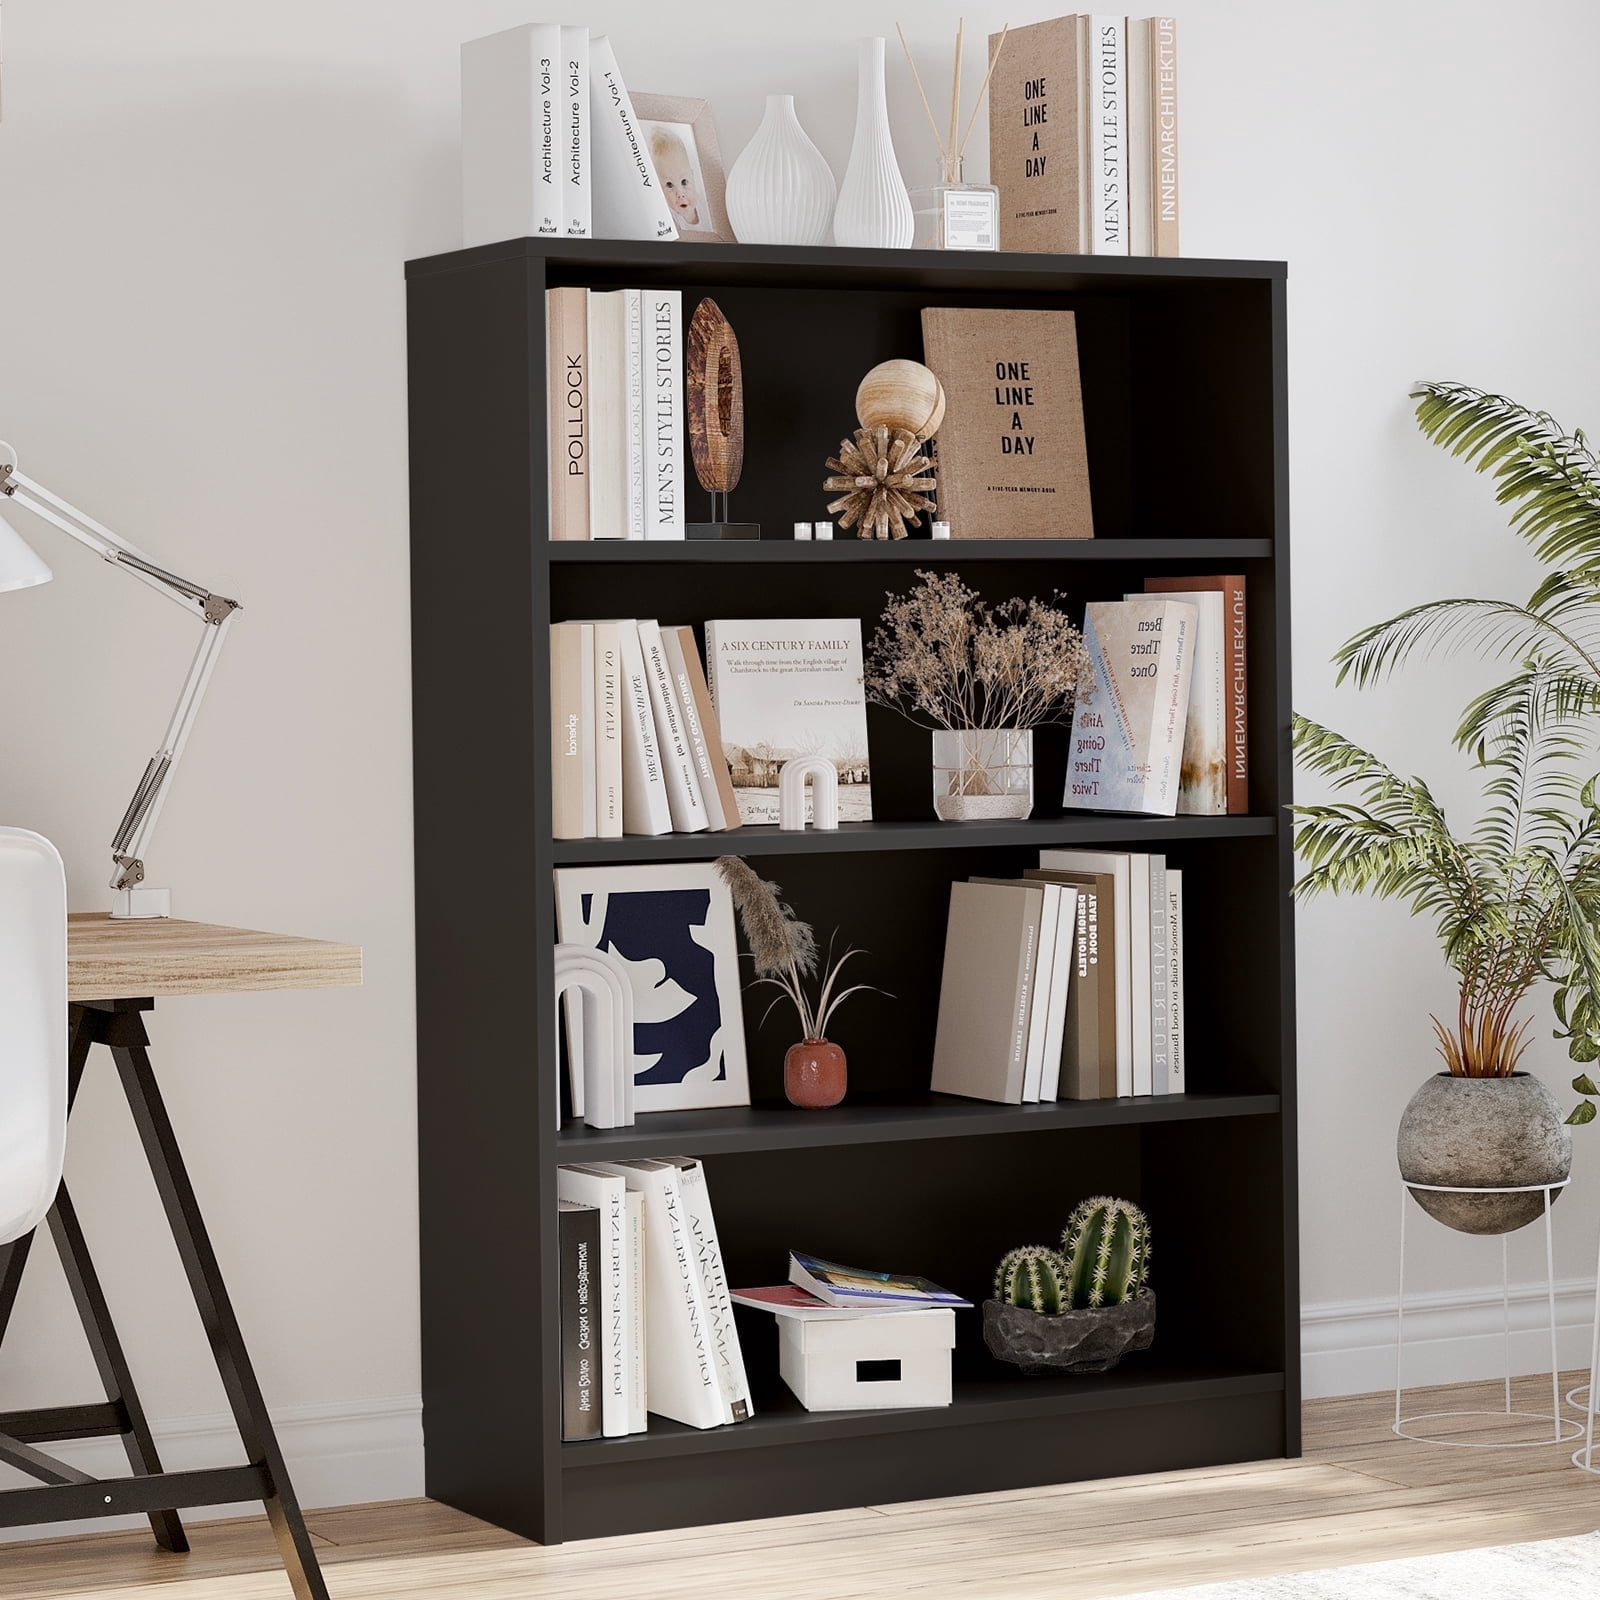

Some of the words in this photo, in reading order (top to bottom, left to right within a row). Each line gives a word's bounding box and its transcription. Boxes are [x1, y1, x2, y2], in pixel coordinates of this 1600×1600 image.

[540, 58, 551, 95] Vol-3
[570, 61, 580, 97] Vol-2
[1102, 25, 1117, 110] STORIES
[604, 72, 621, 106] Vol-1
[1025, 77, 1046, 101] ONE
[1023, 104, 1048, 127] LINE
[1159, 17, 1176, 222] INNENARCHITEKTUR
[542, 101, 552, 184] Architecture
[571, 102, 581, 185] Architecture
[619, 109, 652, 188] Architecture
[1032, 132, 1039, 151] A
[1103, 115, 1118, 178] STYLE
[1025, 156, 1047, 178] DAY
[544, 217, 552, 225] By
[572, 218, 580, 227] By
[1103, 182, 1119, 243] MEN'S
[631, 296, 640, 399] REVOLUTION
[656, 301, 672, 388] STORIES
[996, 362, 1030, 381] ONE
[567, 353, 584, 476] POLLOCK
[995, 387, 1035, 406] LINE
[632, 403, 641, 447] LOOK
[657, 393, 673, 457] STYLE
[1011, 412, 1023, 430] A
[1002, 436, 1035, 455] DAY
[632, 452, 642, 486] NEW
[656, 463, 674, 525] MEN'S
[721, 642, 729, 650] A
[731, 641, 749, 650] SIX
[752, 641, 805, 650] CENTURY
[808, 640, 850, 650] FAMILY
[743, 660, 764, 668] through
[802, 659, 822, 667] English
[824, 658, 840, 666] village
[610, 1193, 621, 1288] GRÜTZKE
[707, 1240, 731, 1316] ТАНЕЦ
[578, 1316, 590, 1350] Сказки
[612, 1292, 623, 1398] JOHANNES
[684, 1282, 713, 1390] JOHANNES
[578, 1358, 591, 1387] Бялко
[578, 1390, 591, 1412] Анна
